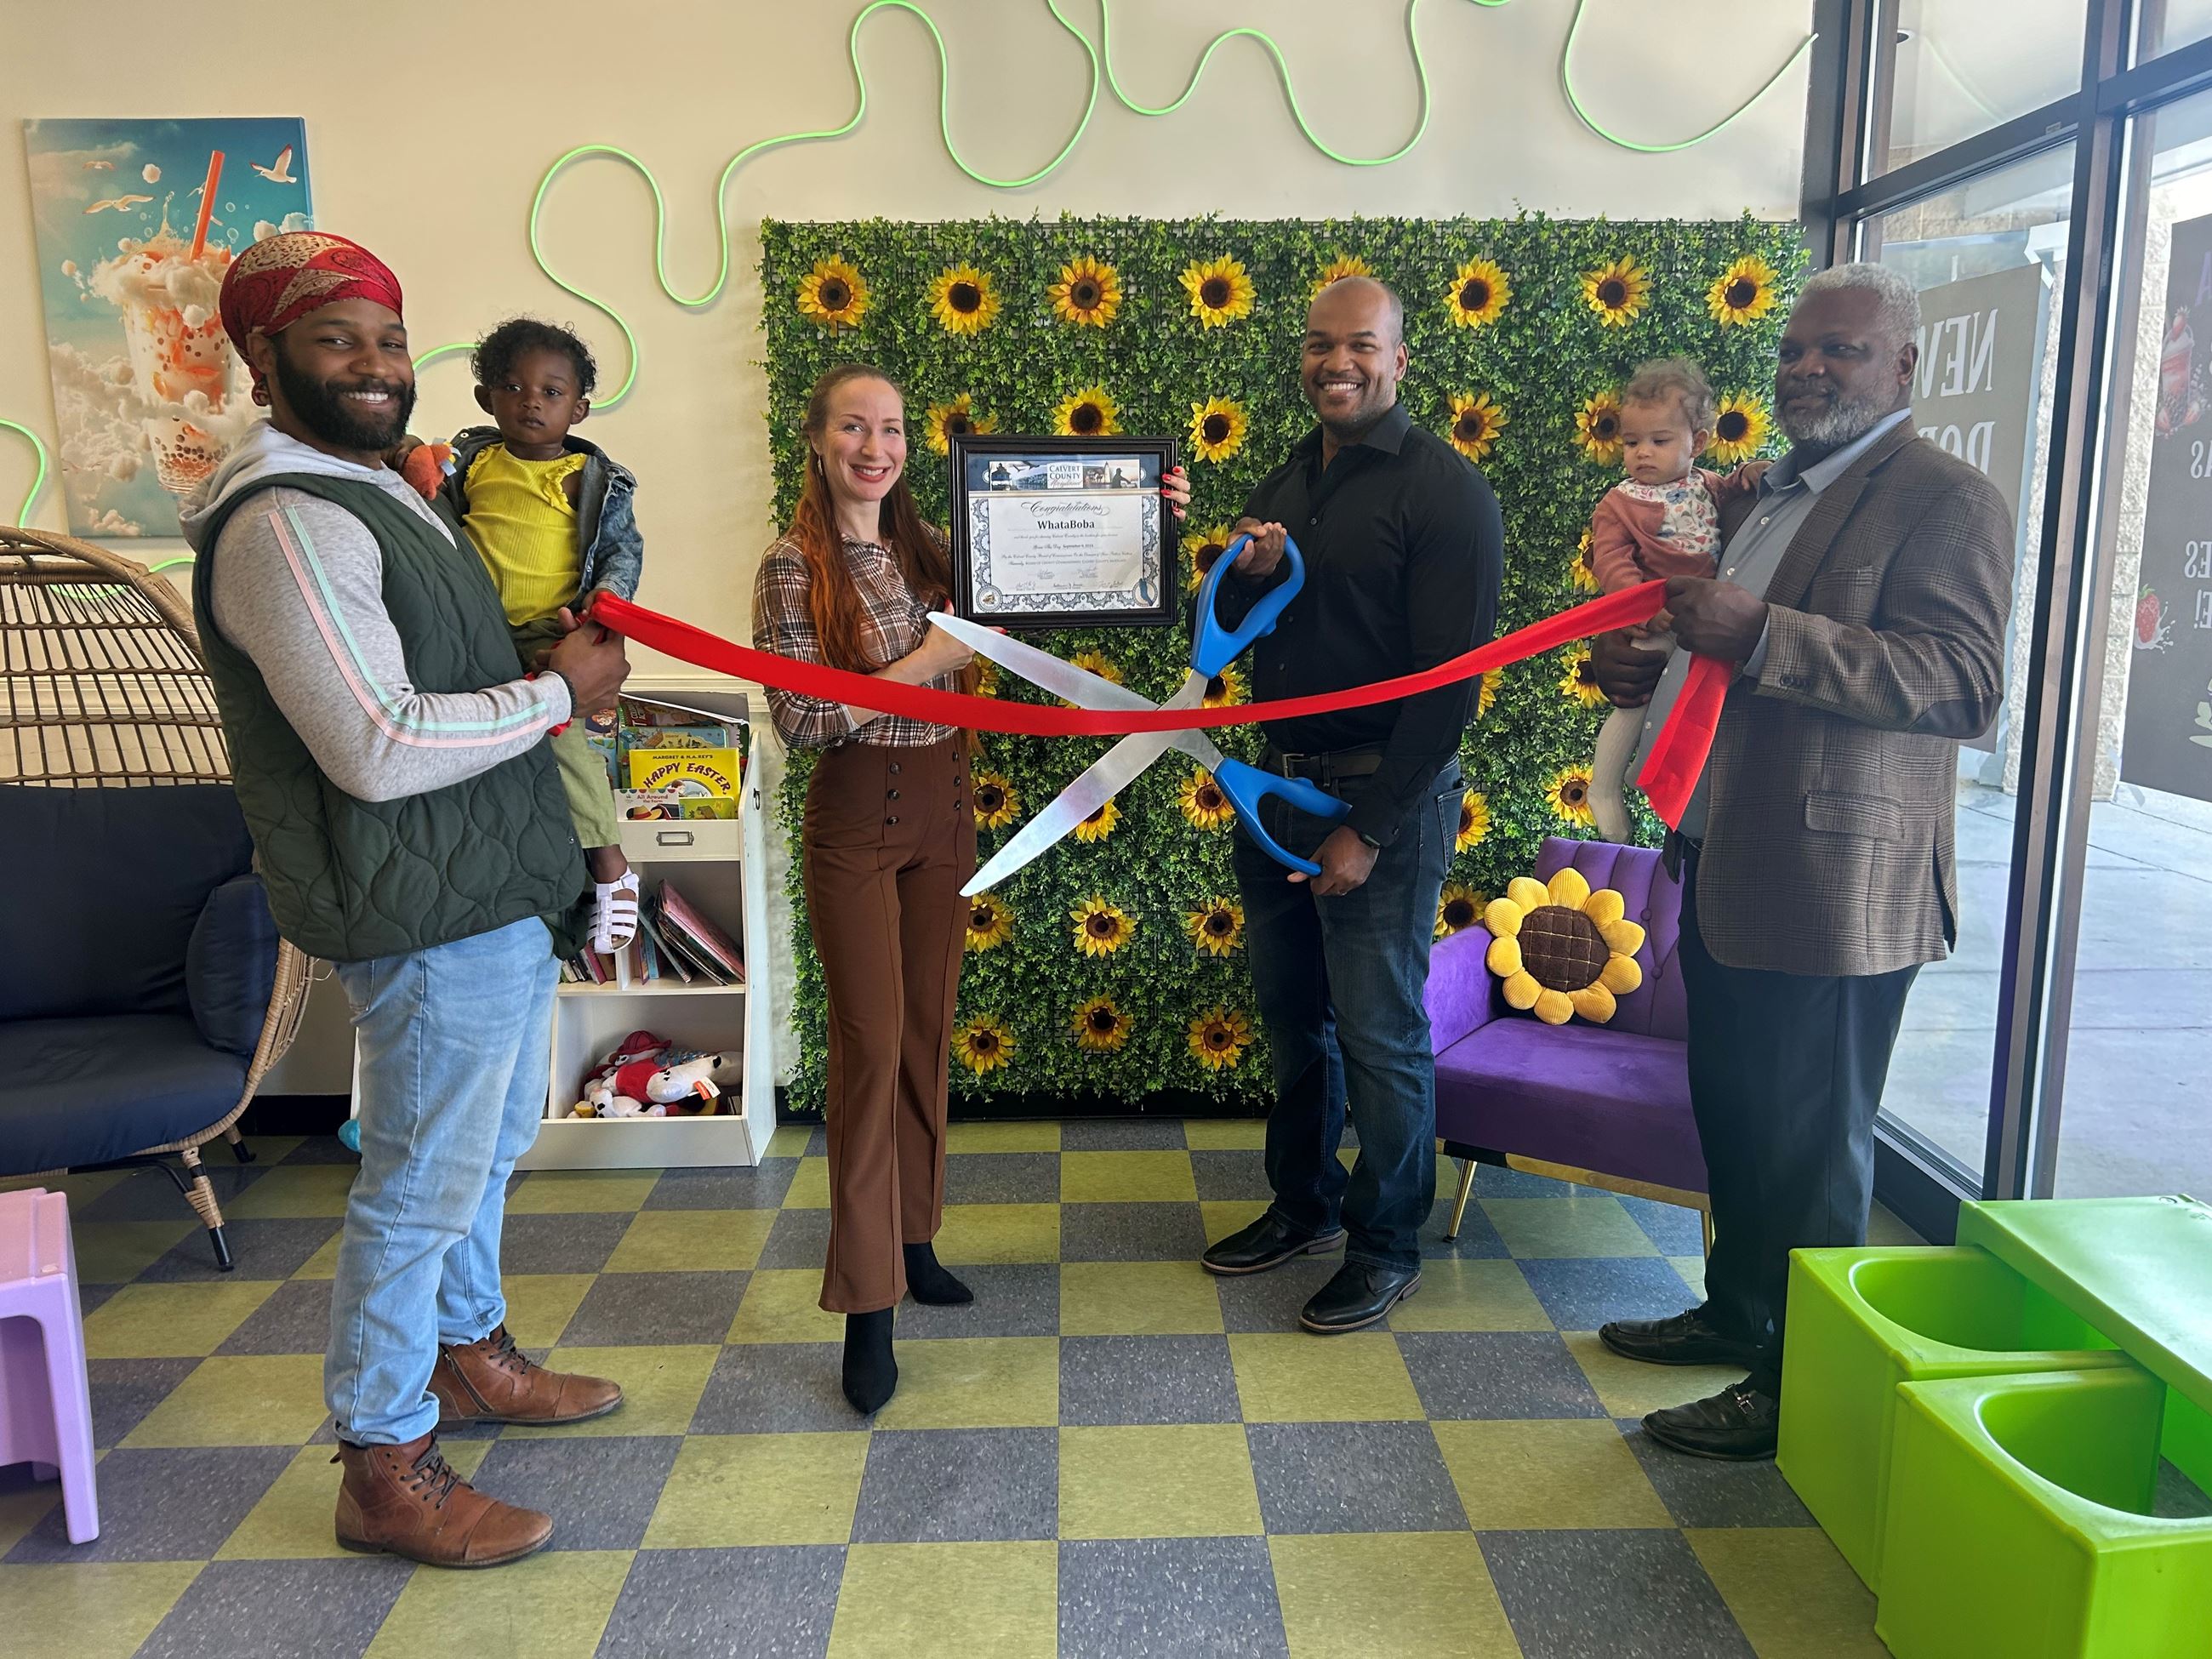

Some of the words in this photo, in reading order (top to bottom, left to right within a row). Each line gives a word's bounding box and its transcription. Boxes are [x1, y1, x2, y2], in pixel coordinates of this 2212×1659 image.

[1020, 500, 1110, 517] Congratulations
[1037, 520, 1095, 530] WhataBoba
[643, 762, 681, 789] HAPPY
